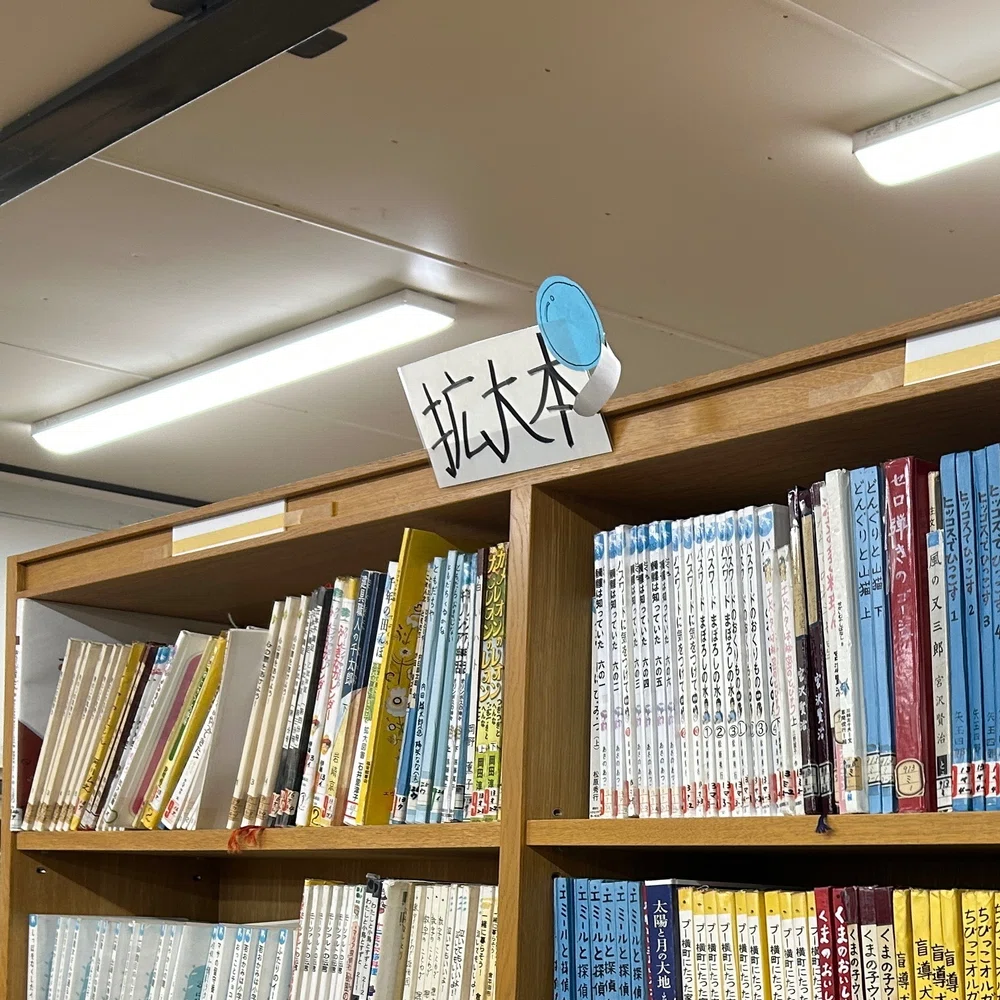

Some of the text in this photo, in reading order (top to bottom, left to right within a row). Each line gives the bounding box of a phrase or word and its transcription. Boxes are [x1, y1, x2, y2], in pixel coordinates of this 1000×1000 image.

[652, 900, 671, 989] 太陽と月の大地
